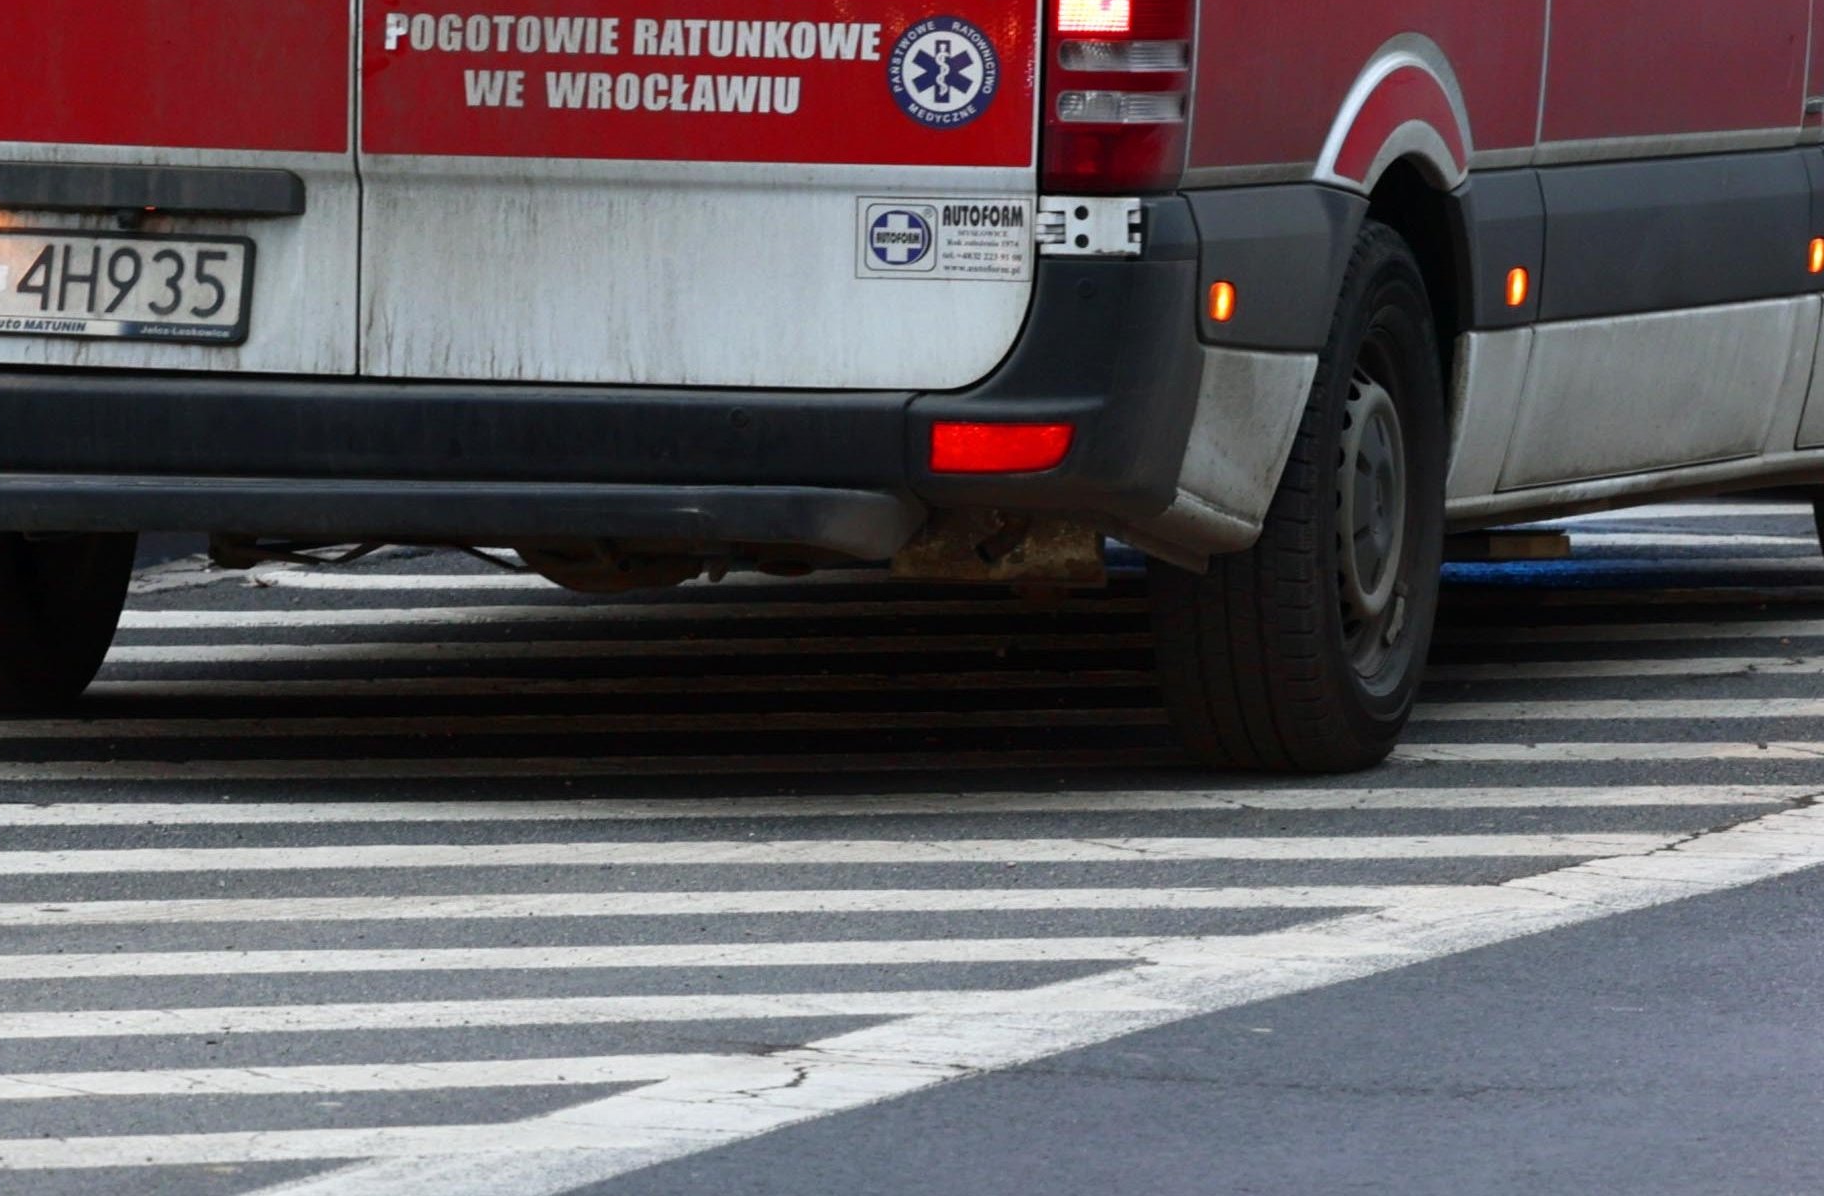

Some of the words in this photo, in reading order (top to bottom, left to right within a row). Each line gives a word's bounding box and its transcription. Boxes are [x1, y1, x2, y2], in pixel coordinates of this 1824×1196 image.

[384, 13, 618, 57] POGOTOWIE
[632, 19, 881, 62] RATUNKOWE
[952, 21, 996, 94] RATOWNICTWO
[464, 70, 525, 109] WE
[546, 72, 802, 115] WROCŁAWIU
[908, 103, 977, 123] MEDYCZNE
[942, 205, 1024, 228] AUTOFORM
[876, 231, 920, 245] AUTOFORM
[16, 244, 228, 318] 4H935
[23, 320, 87, 332] MATUNIN
